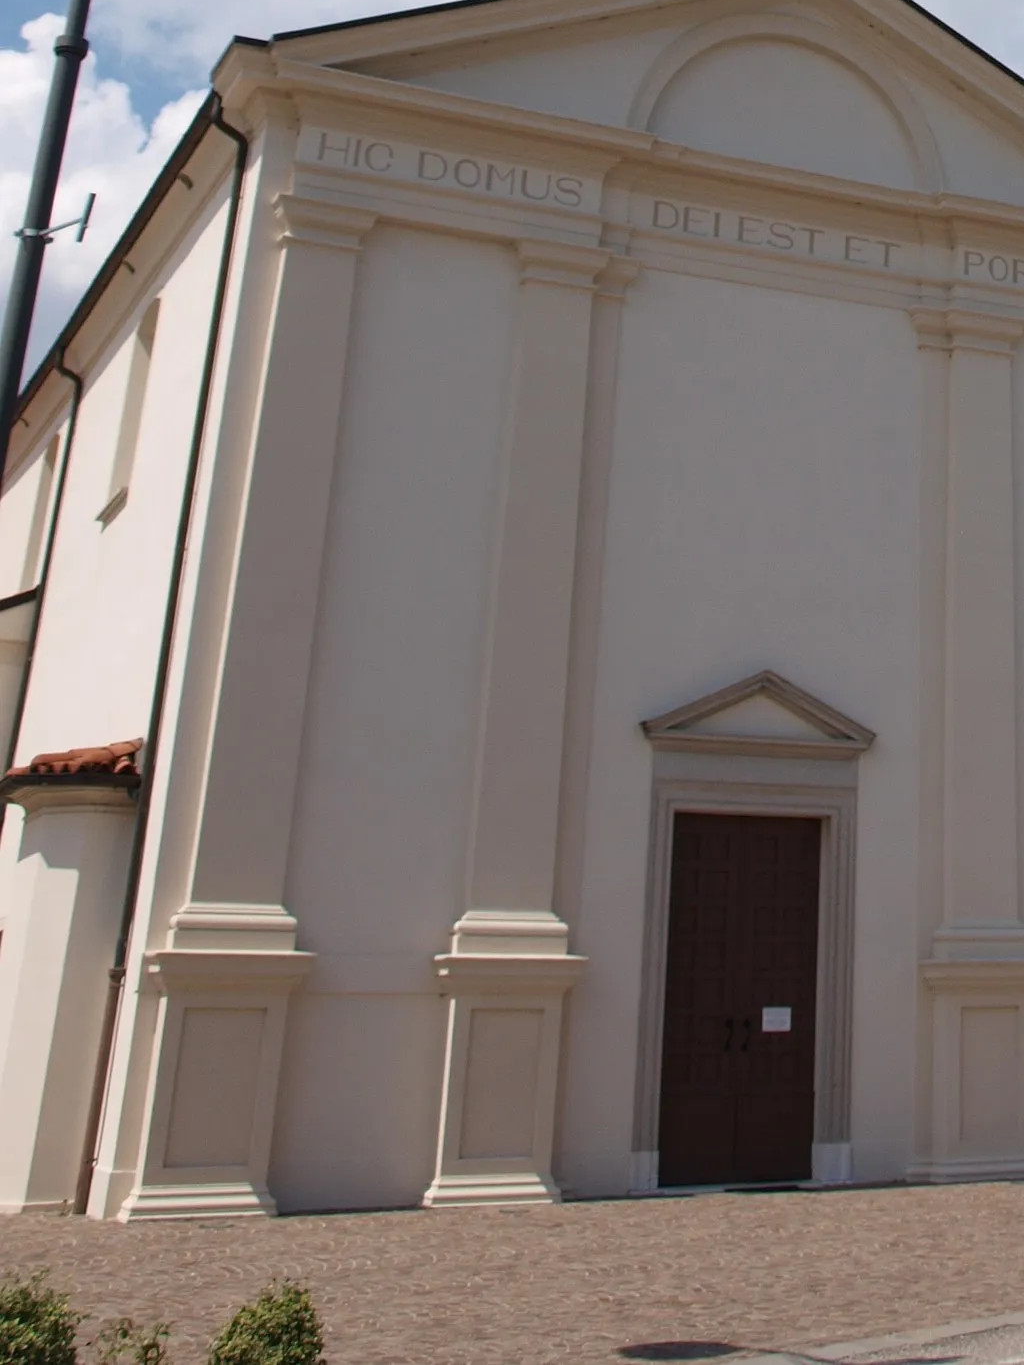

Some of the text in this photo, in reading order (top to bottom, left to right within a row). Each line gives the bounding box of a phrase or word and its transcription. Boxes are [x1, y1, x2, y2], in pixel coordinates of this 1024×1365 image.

[317, 132, 394, 172] HIC
[418, 149, 583, 207] DOMUS
[652, 200, 721, 238] DEI
[736, 216, 825, 255] EST
[844, 234, 900, 267] ET
